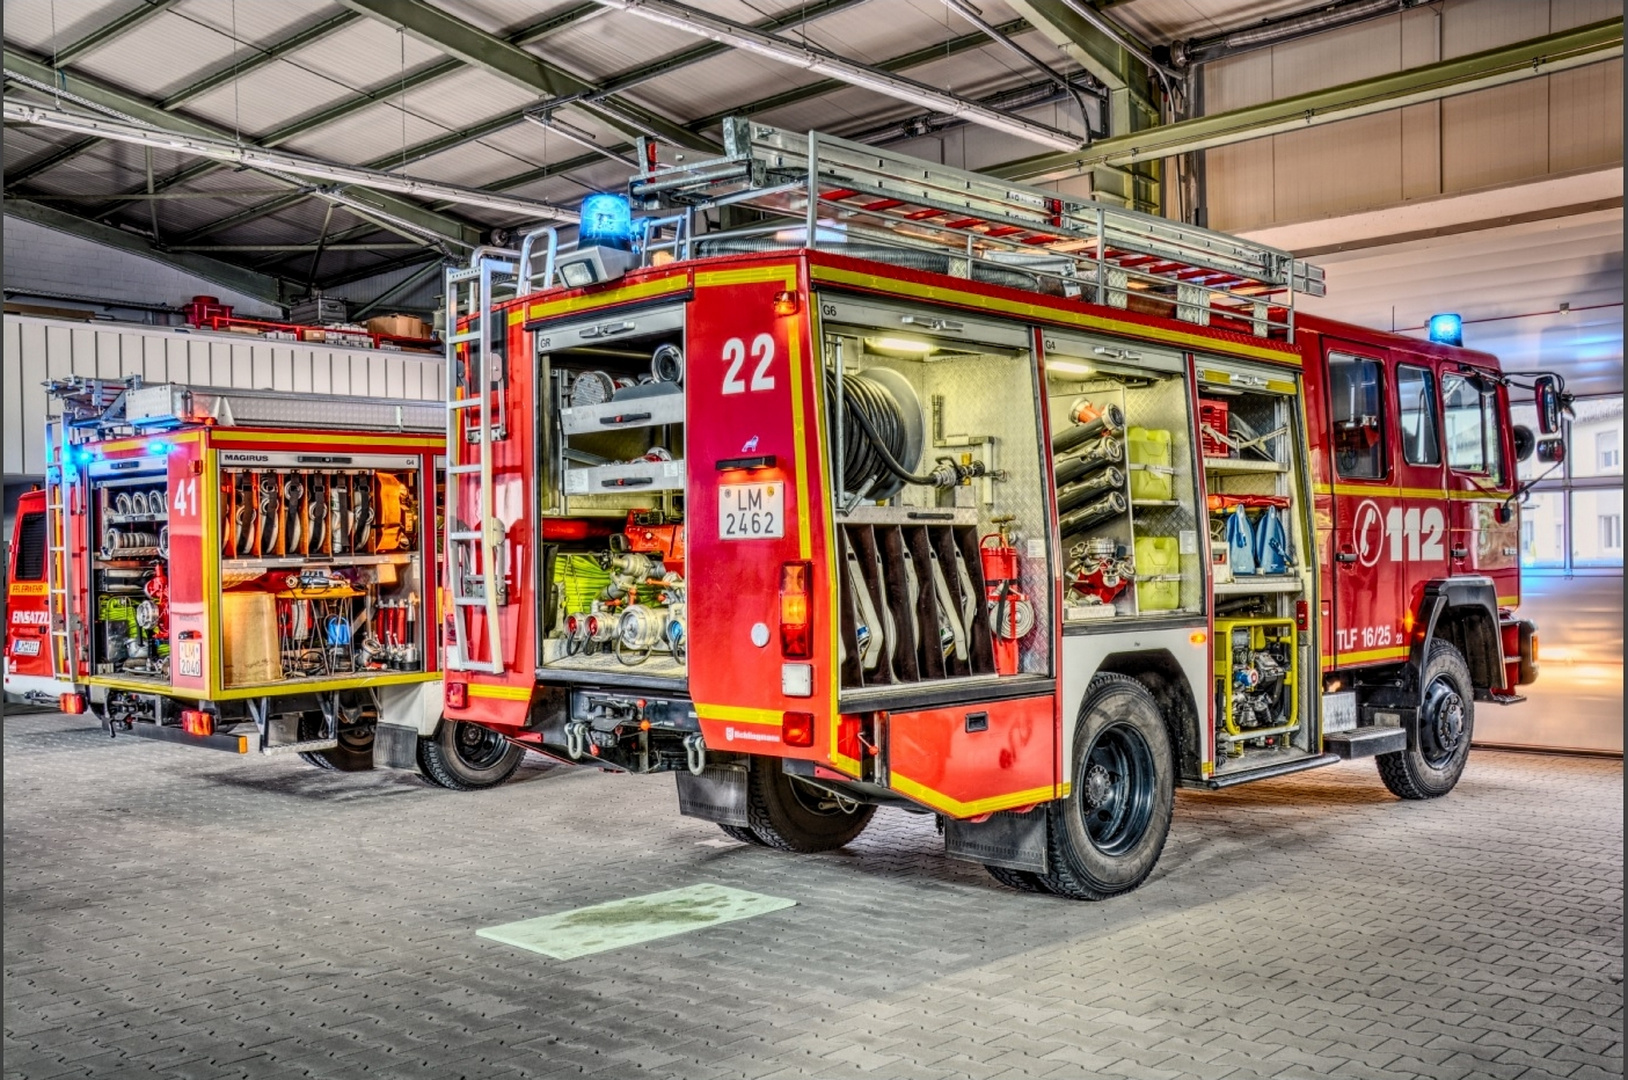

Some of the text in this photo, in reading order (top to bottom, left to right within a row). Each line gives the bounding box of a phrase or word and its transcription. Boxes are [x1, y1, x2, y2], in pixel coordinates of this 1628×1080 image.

[823, 304, 837, 317] G6
[540, 337, 551, 348] GR
[1045, 340, 1056, 351] G4
[722, 332, 775, 395] 22
[224, 454, 269, 462] MAGIRUS
[174, 477, 197, 517] 41
[738, 488, 762, 511] LM
[726, 512, 774, 535] 2462
[1385, 507, 1444, 561] 112
[1336, 625, 1403, 651] TLF 16/25 22
[181, 660, 200, 675] 2040
